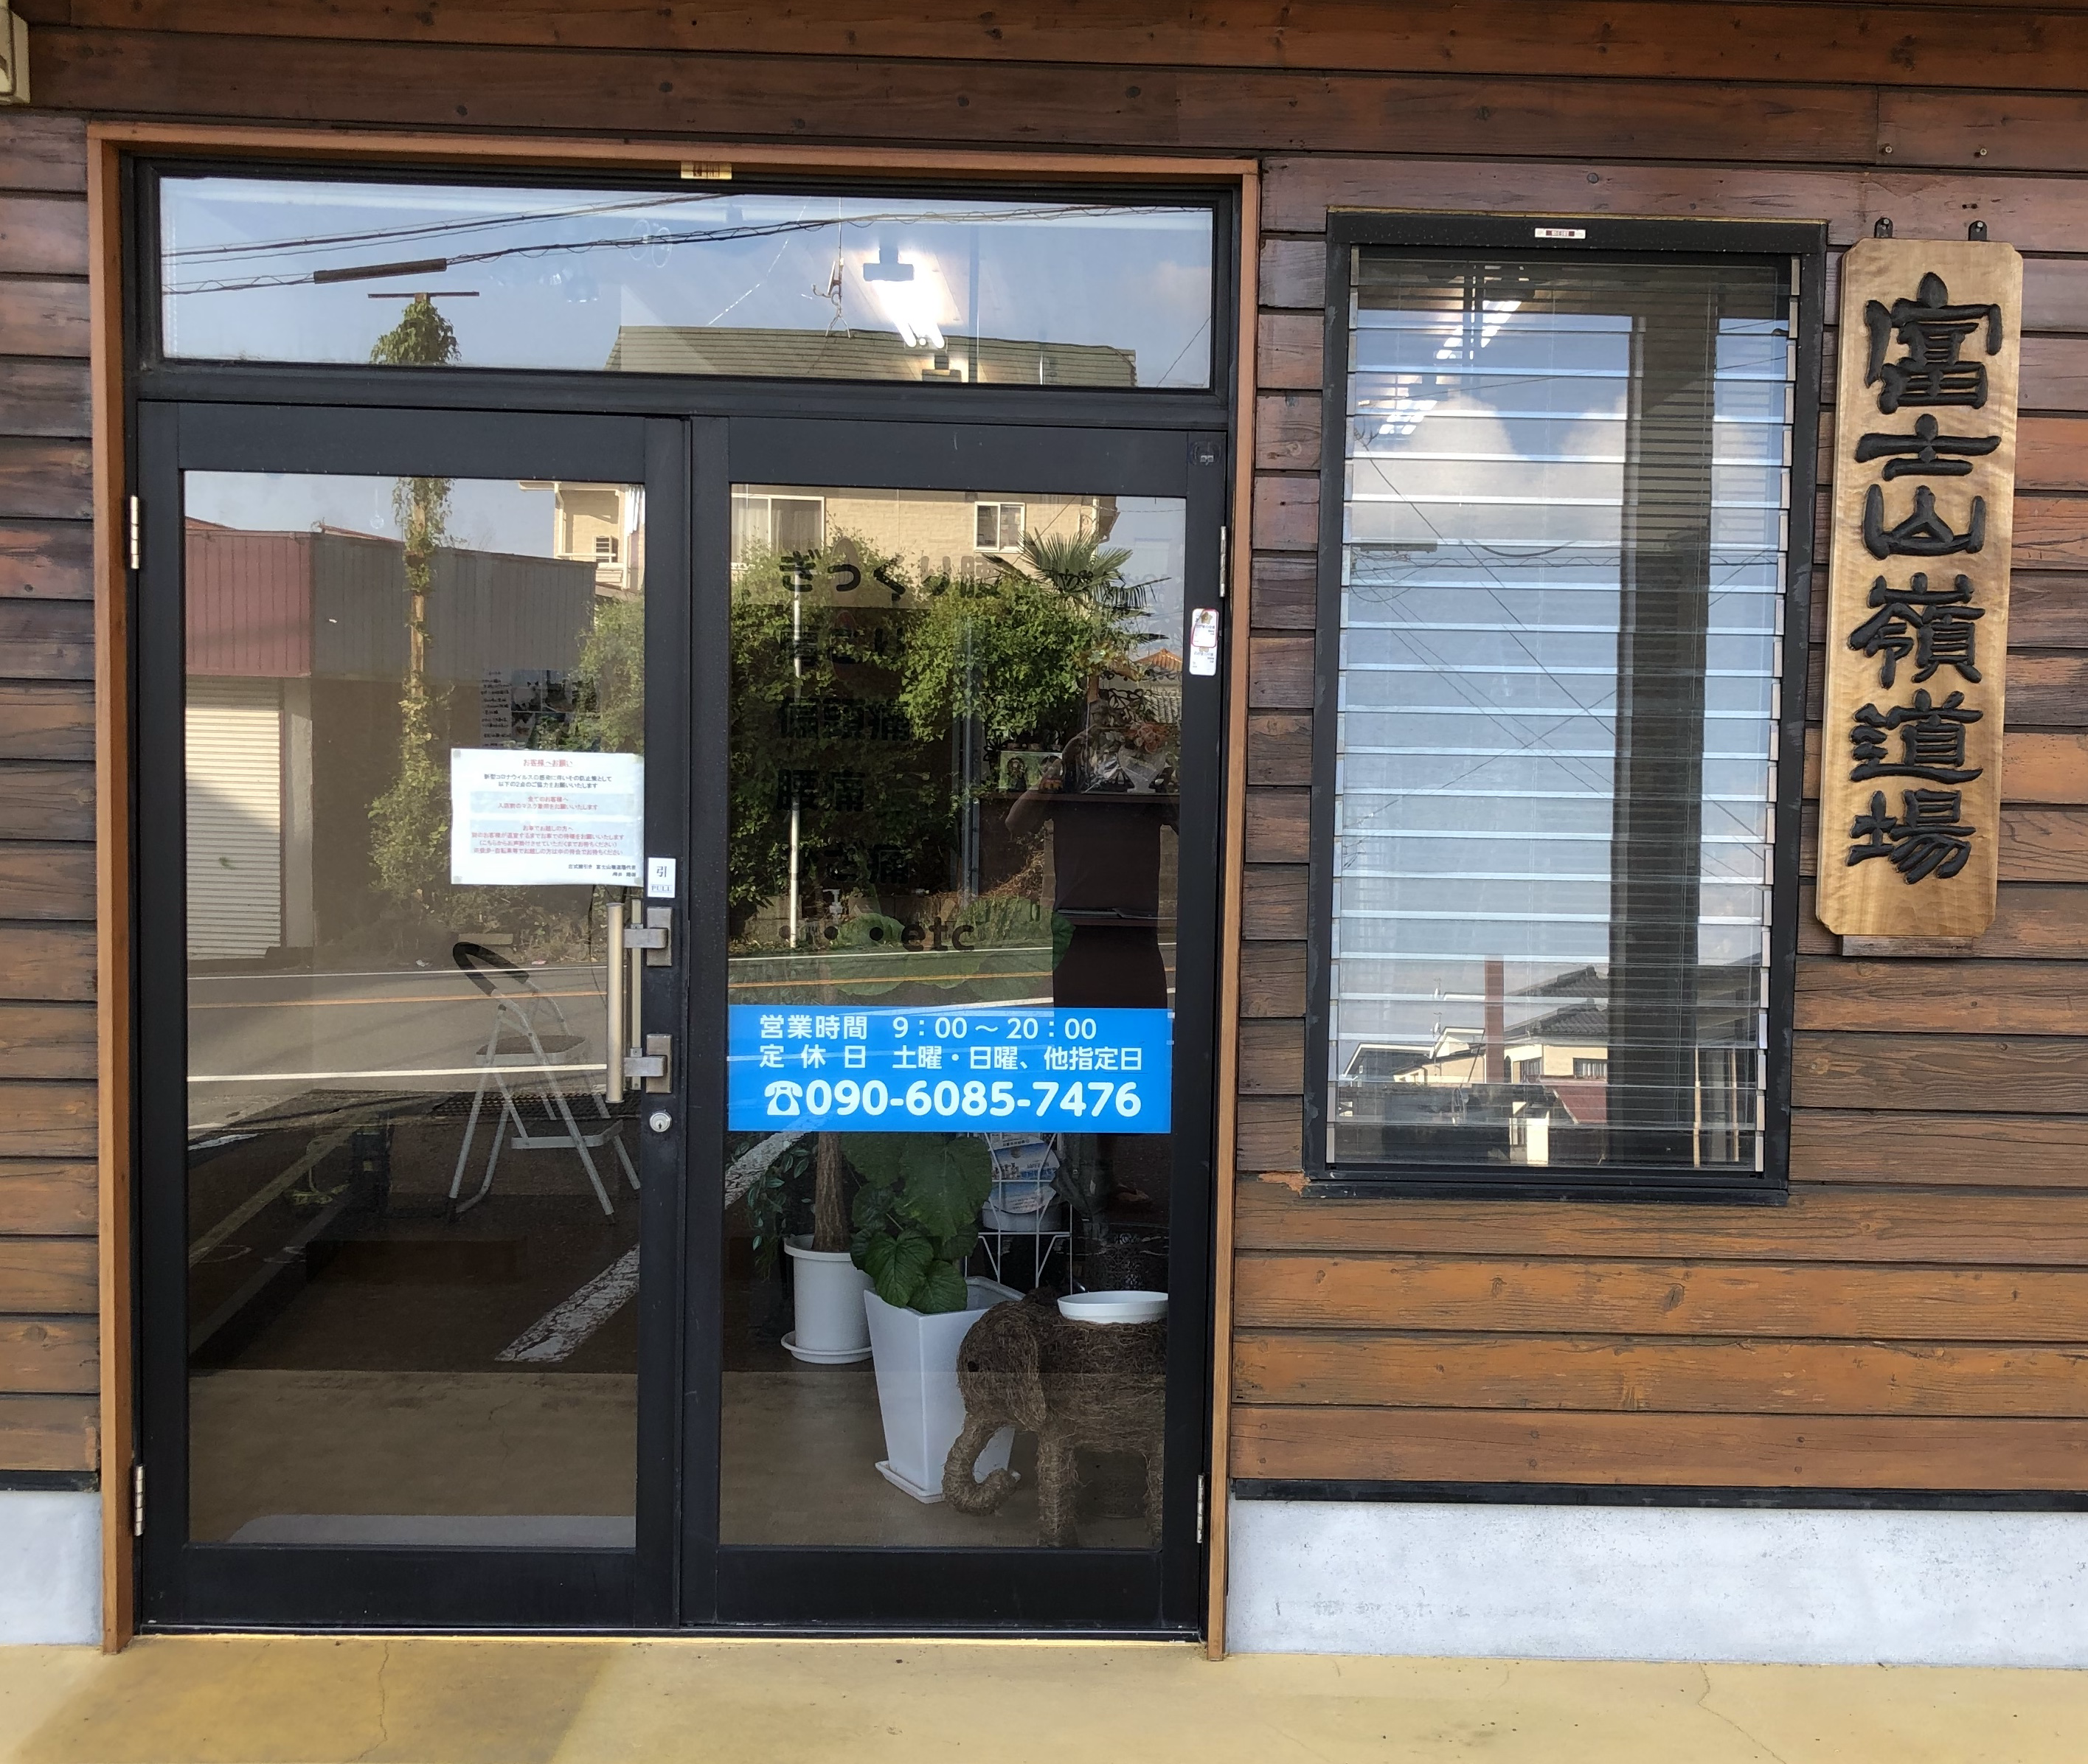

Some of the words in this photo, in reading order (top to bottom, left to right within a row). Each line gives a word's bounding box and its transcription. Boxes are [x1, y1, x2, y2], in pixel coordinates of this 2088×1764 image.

[778, 695, 911, 741] 偏頭痛
[777, 768, 865, 813] 腰痛
[656, 866, 667, 878] 引
[759, 1015, 867, 1040] 営業時間
[892, 1045, 1142, 1072] 土曜・日曜、他指定日
[805, 1079, 1142, 1117] 090-6085-7476
